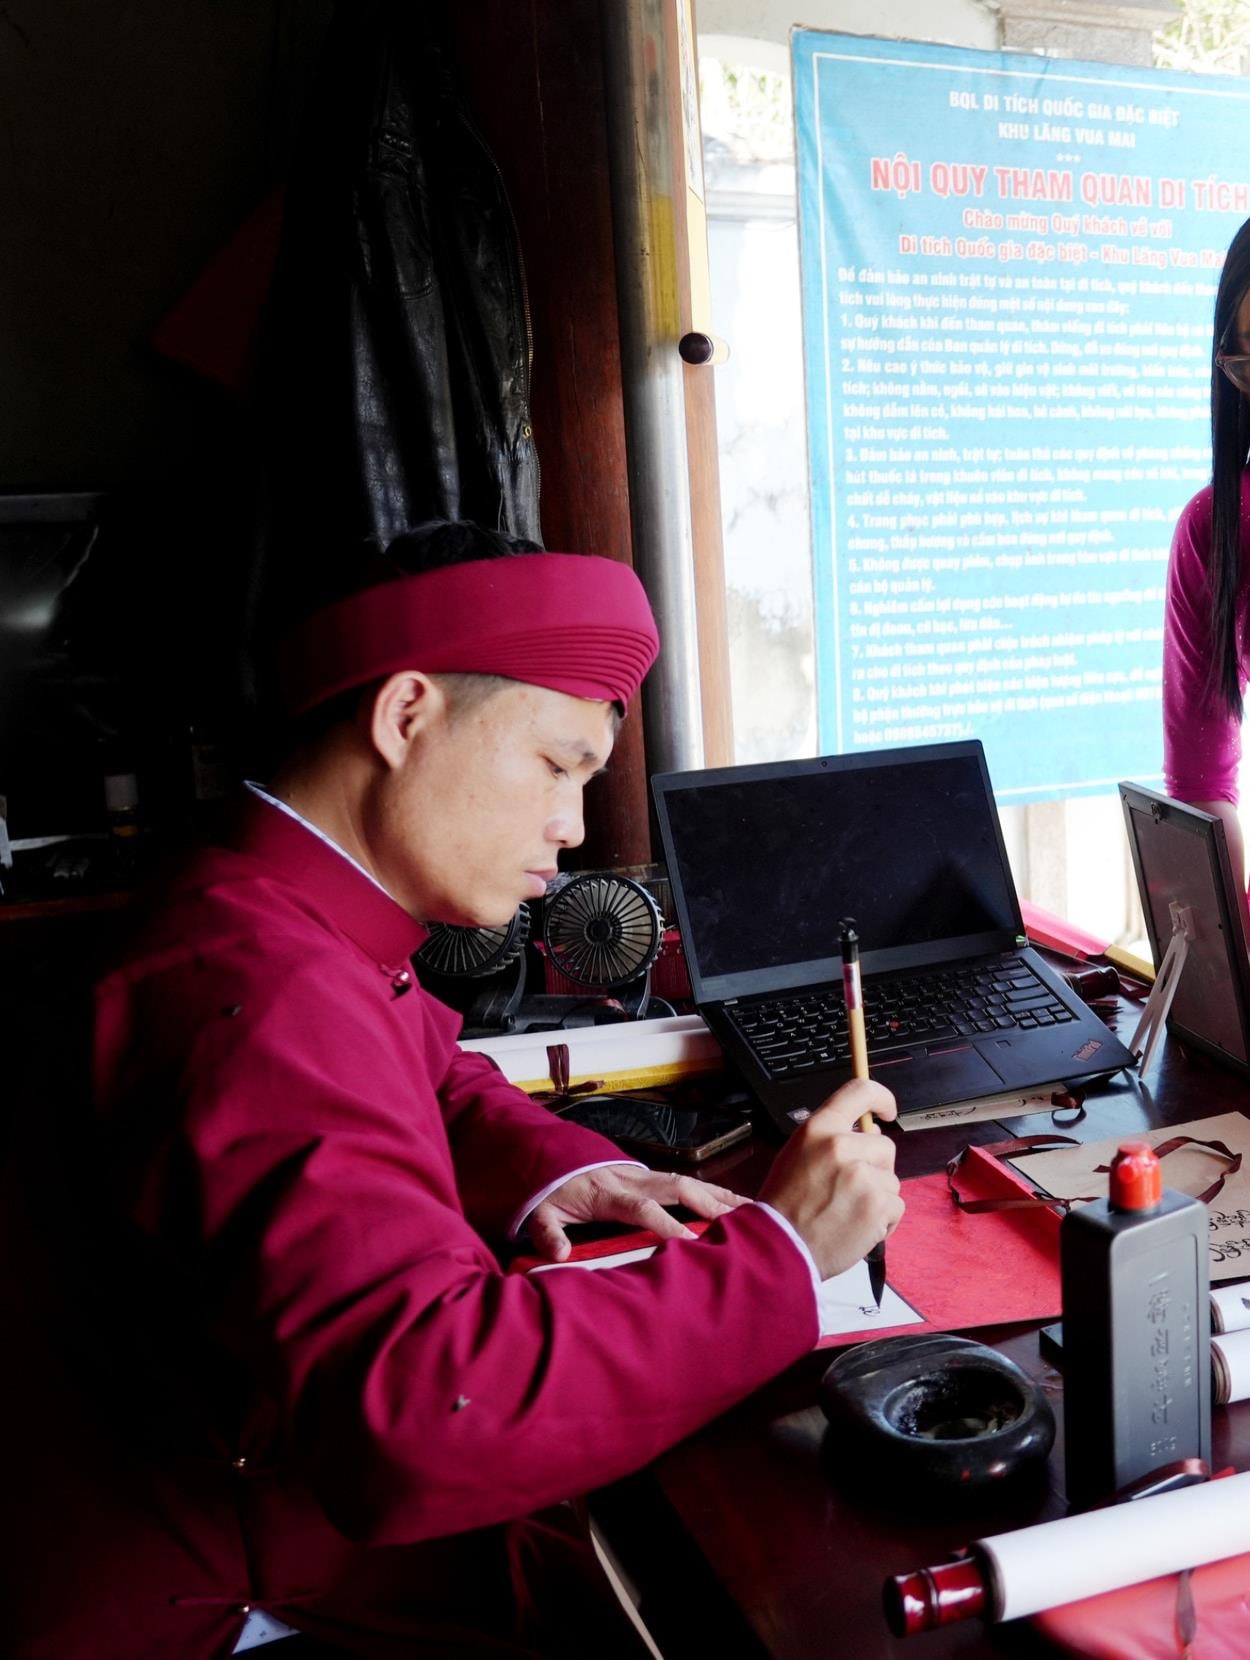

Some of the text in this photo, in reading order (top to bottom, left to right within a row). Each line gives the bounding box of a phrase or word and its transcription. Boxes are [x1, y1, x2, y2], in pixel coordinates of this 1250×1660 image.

[950, 90, 1180, 129] BQL DI TÍCH QUỐC GIA ĐẶC BIỆT
[998, 122, 1029, 139] KHU
[1076, 129, 1104, 145] VUA
[1108, 132, 1136, 148] MAI
[871, 152, 1249, 213] NỘI QUY THAM QUAN DI TÍCH
[962, 208, 1003, 229] Chào
[1007, 210, 1048, 234] mừng
[1052, 213, 1081, 236] Quý
[1084, 214, 1127, 236] khách
[899, 235, 918, 255] Di
[921, 236, 952, 256] tích
[956, 236, 995, 258] Quốc
[998, 240, 1024, 263] gia
[1026, 241, 1054, 264] đặc
[1058, 242, 1088, 265] biệt
[1101, 244, 1129, 264] Khu
[1169, 247, 1199, 267] Vua
